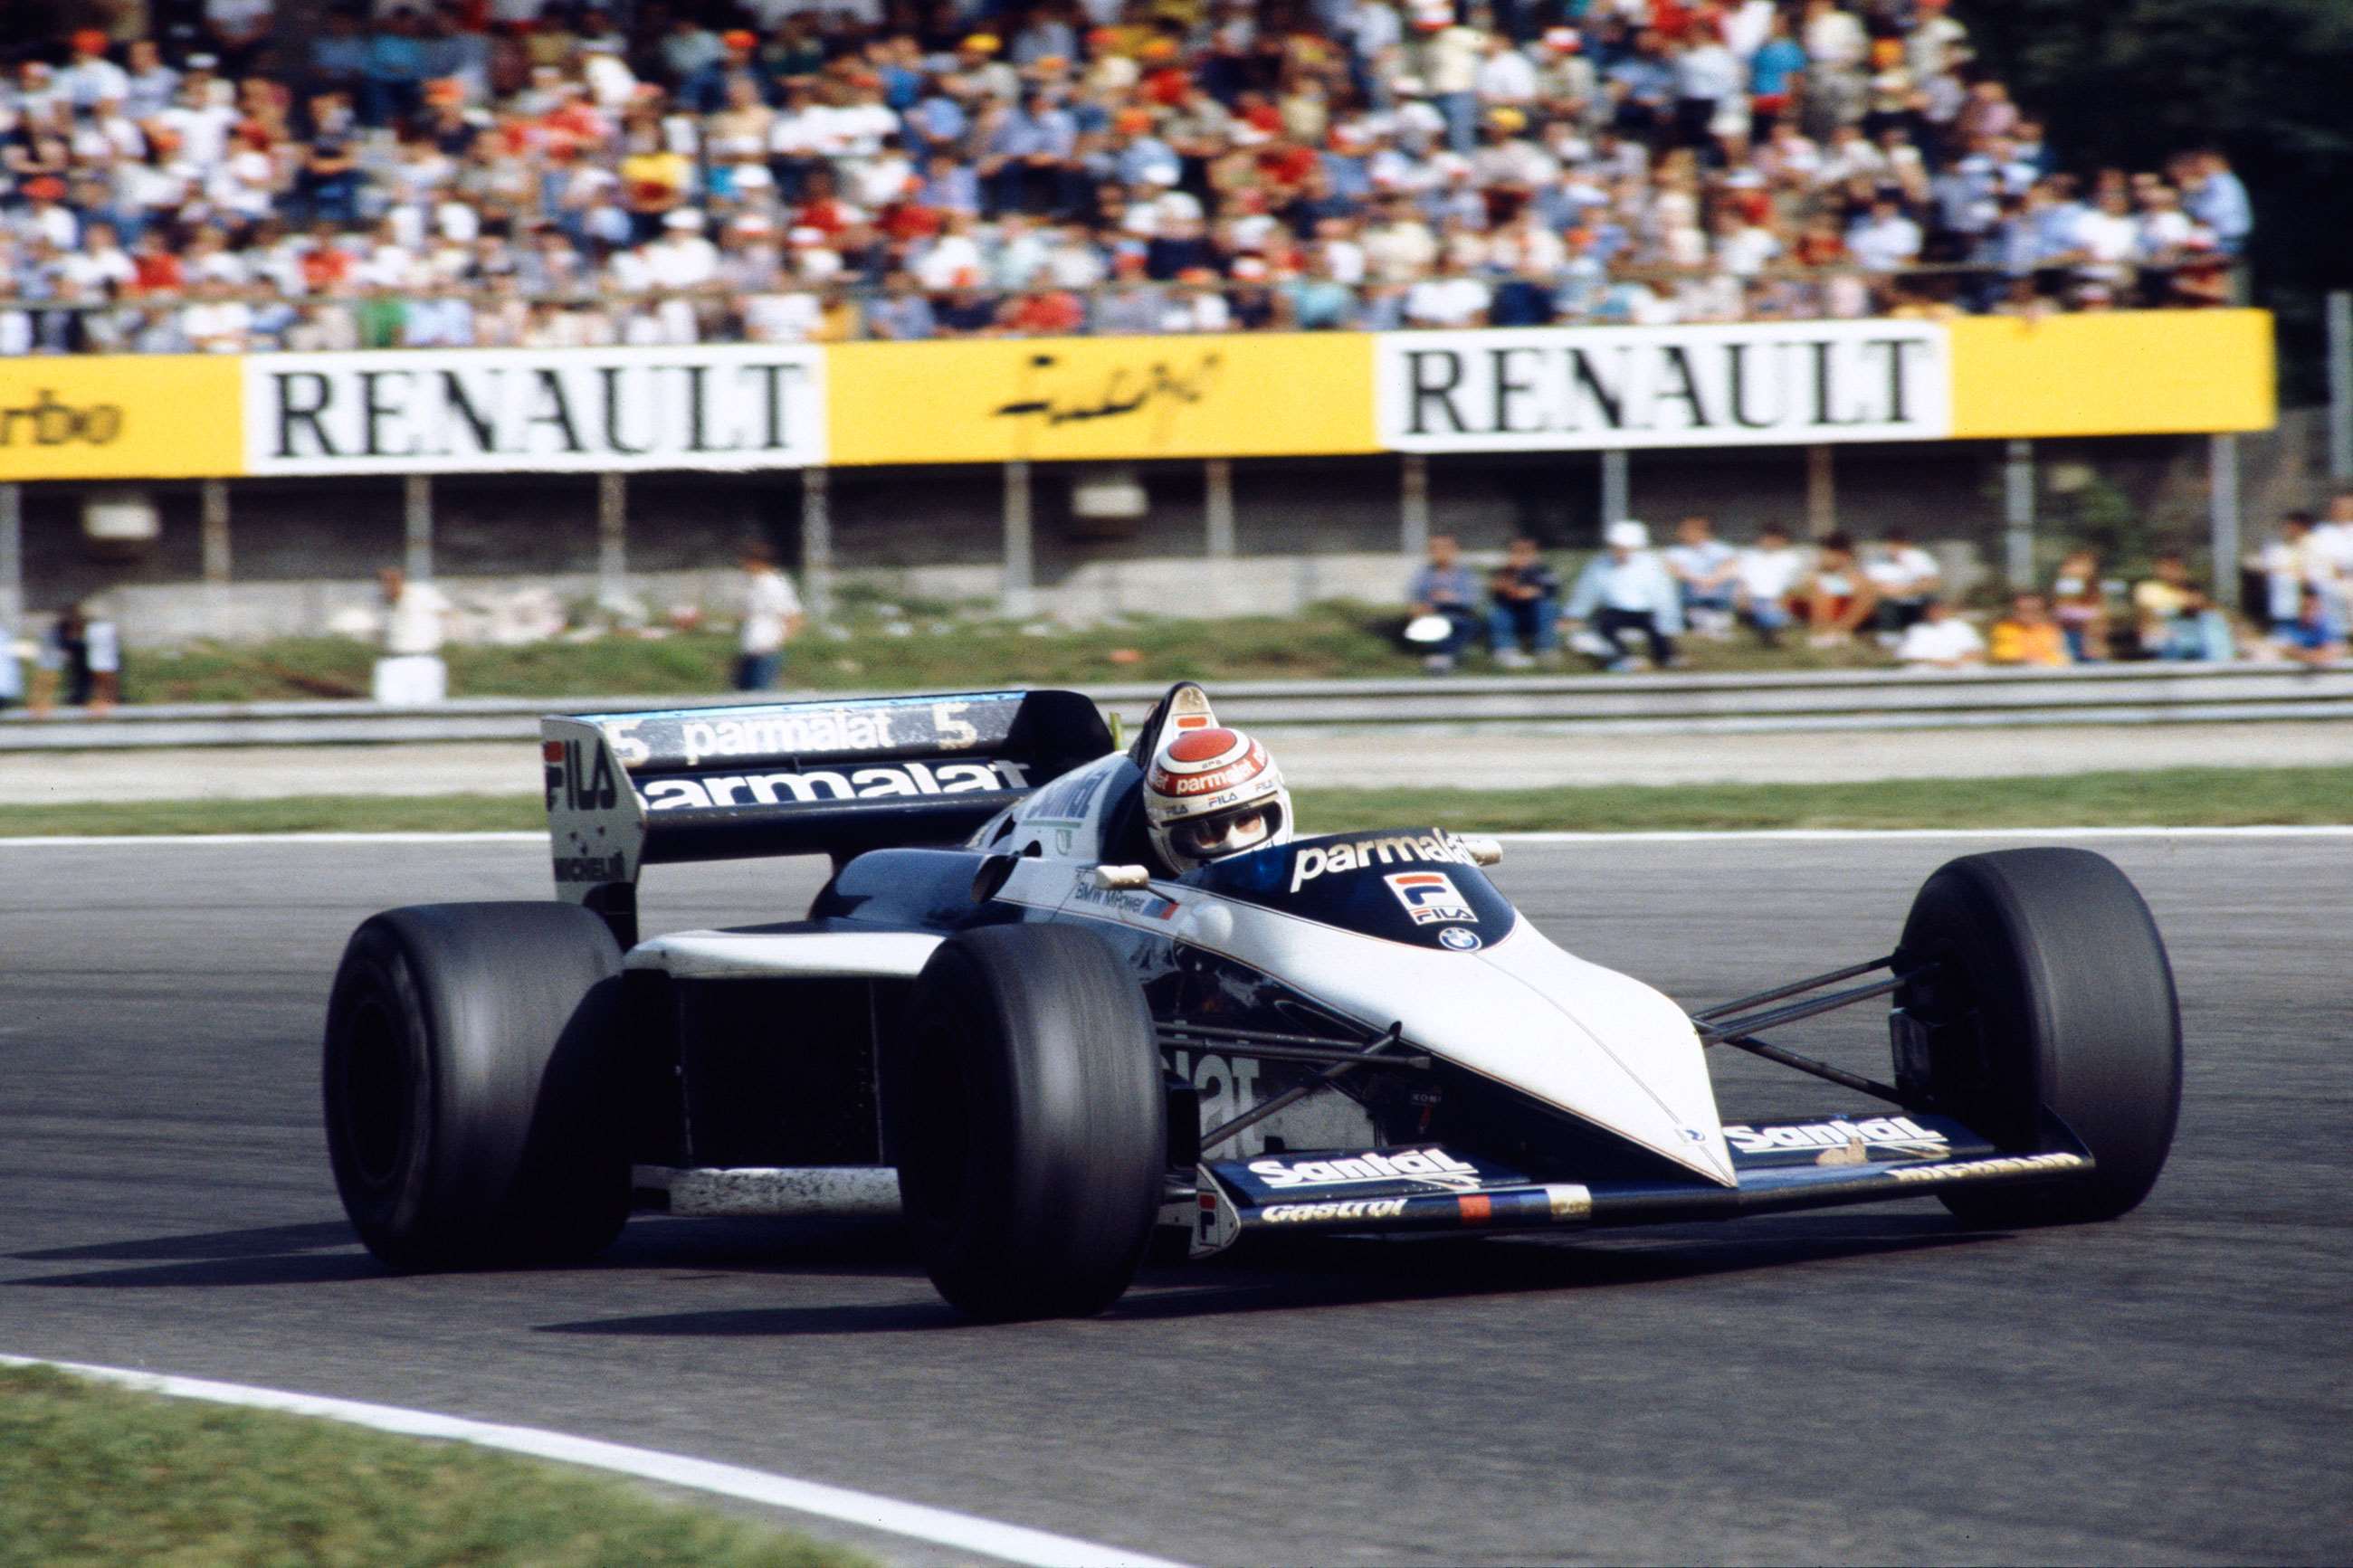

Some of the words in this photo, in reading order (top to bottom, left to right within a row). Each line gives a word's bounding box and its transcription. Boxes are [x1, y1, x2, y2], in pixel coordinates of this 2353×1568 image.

[271, 363, 799, 457] RENAULT
[1402, 338, 1927, 434] RENAULT
[681, 707, 897, 765] parmalat
[932, 702, 978, 749] 5
[635, 759, 1029, 811] armalat
[1208, 792, 1238, 808] FILA
[1414, 908, 1474, 923] FILA
